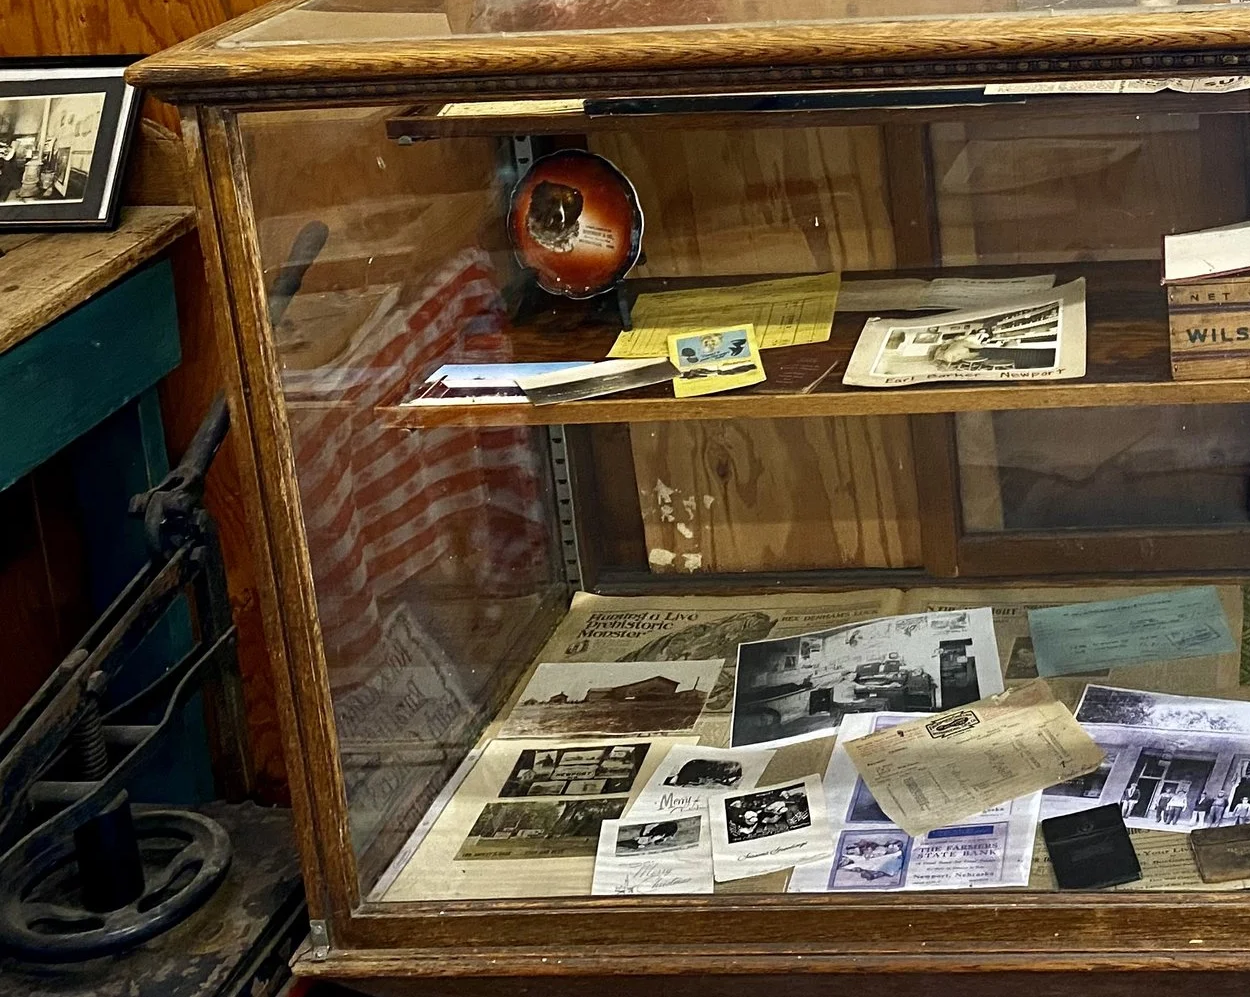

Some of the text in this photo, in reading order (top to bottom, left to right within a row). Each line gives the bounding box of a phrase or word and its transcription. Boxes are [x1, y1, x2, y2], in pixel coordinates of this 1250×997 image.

[1190, 292, 1231, 301] NET
[885, 376, 915, 384] Earl
[1000, 368, 1066, 379] Newport
[665, 612, 698, 621] Live
[946, 843, 998, 851] FARMERS
